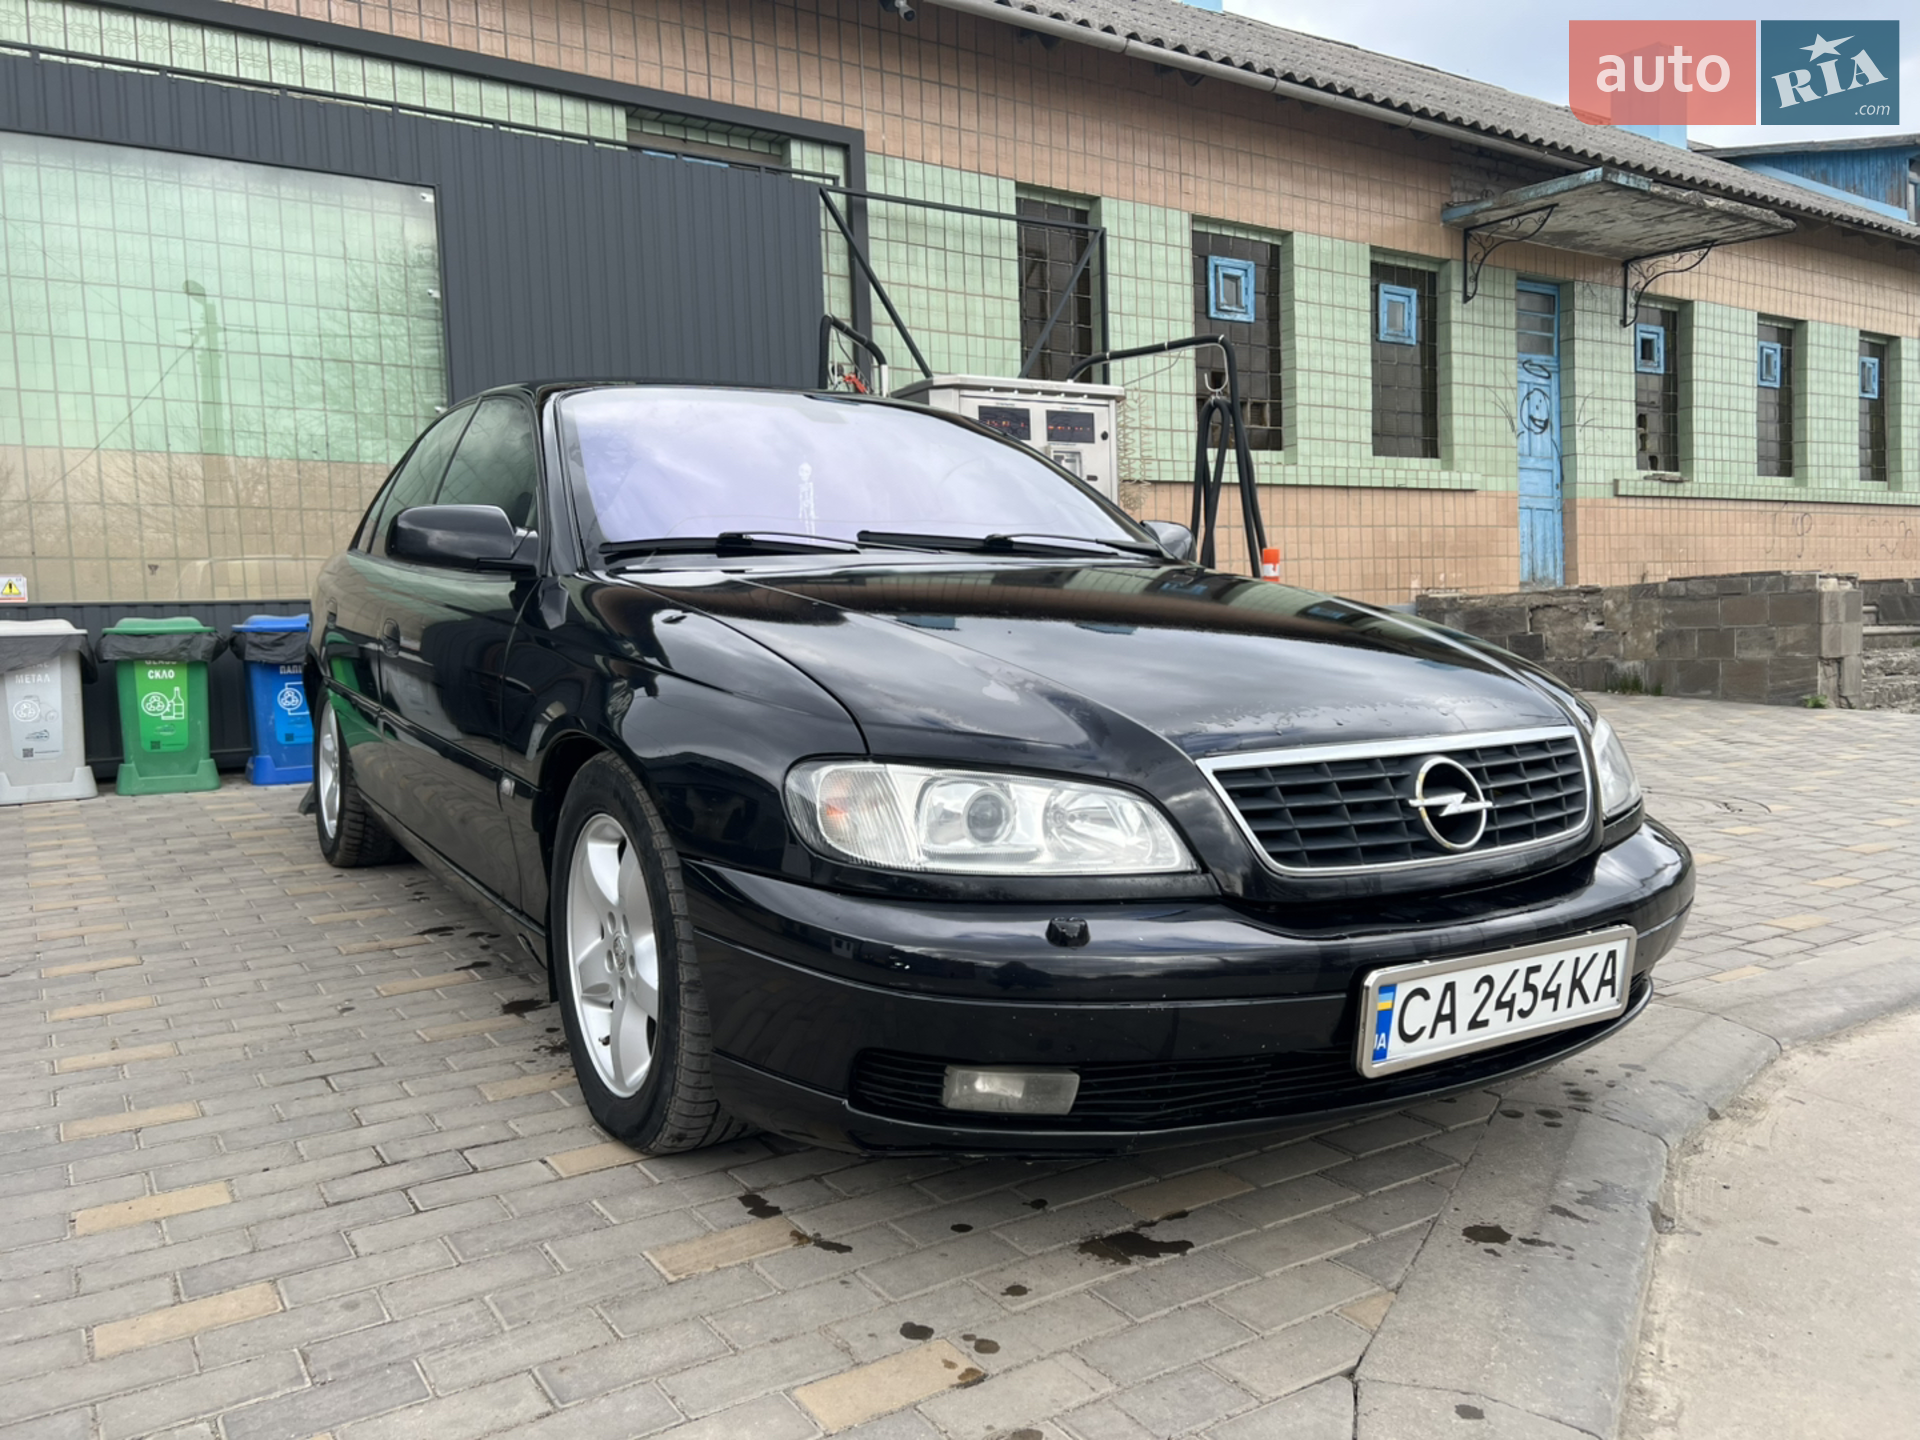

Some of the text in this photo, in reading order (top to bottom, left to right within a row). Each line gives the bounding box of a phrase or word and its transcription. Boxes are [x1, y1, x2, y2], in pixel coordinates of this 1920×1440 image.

[15, 673, 51, 684] МЕТАЛ
[147, 669, 176, 680] СКЛО
[1397, 980, 1457, 1044] CA
